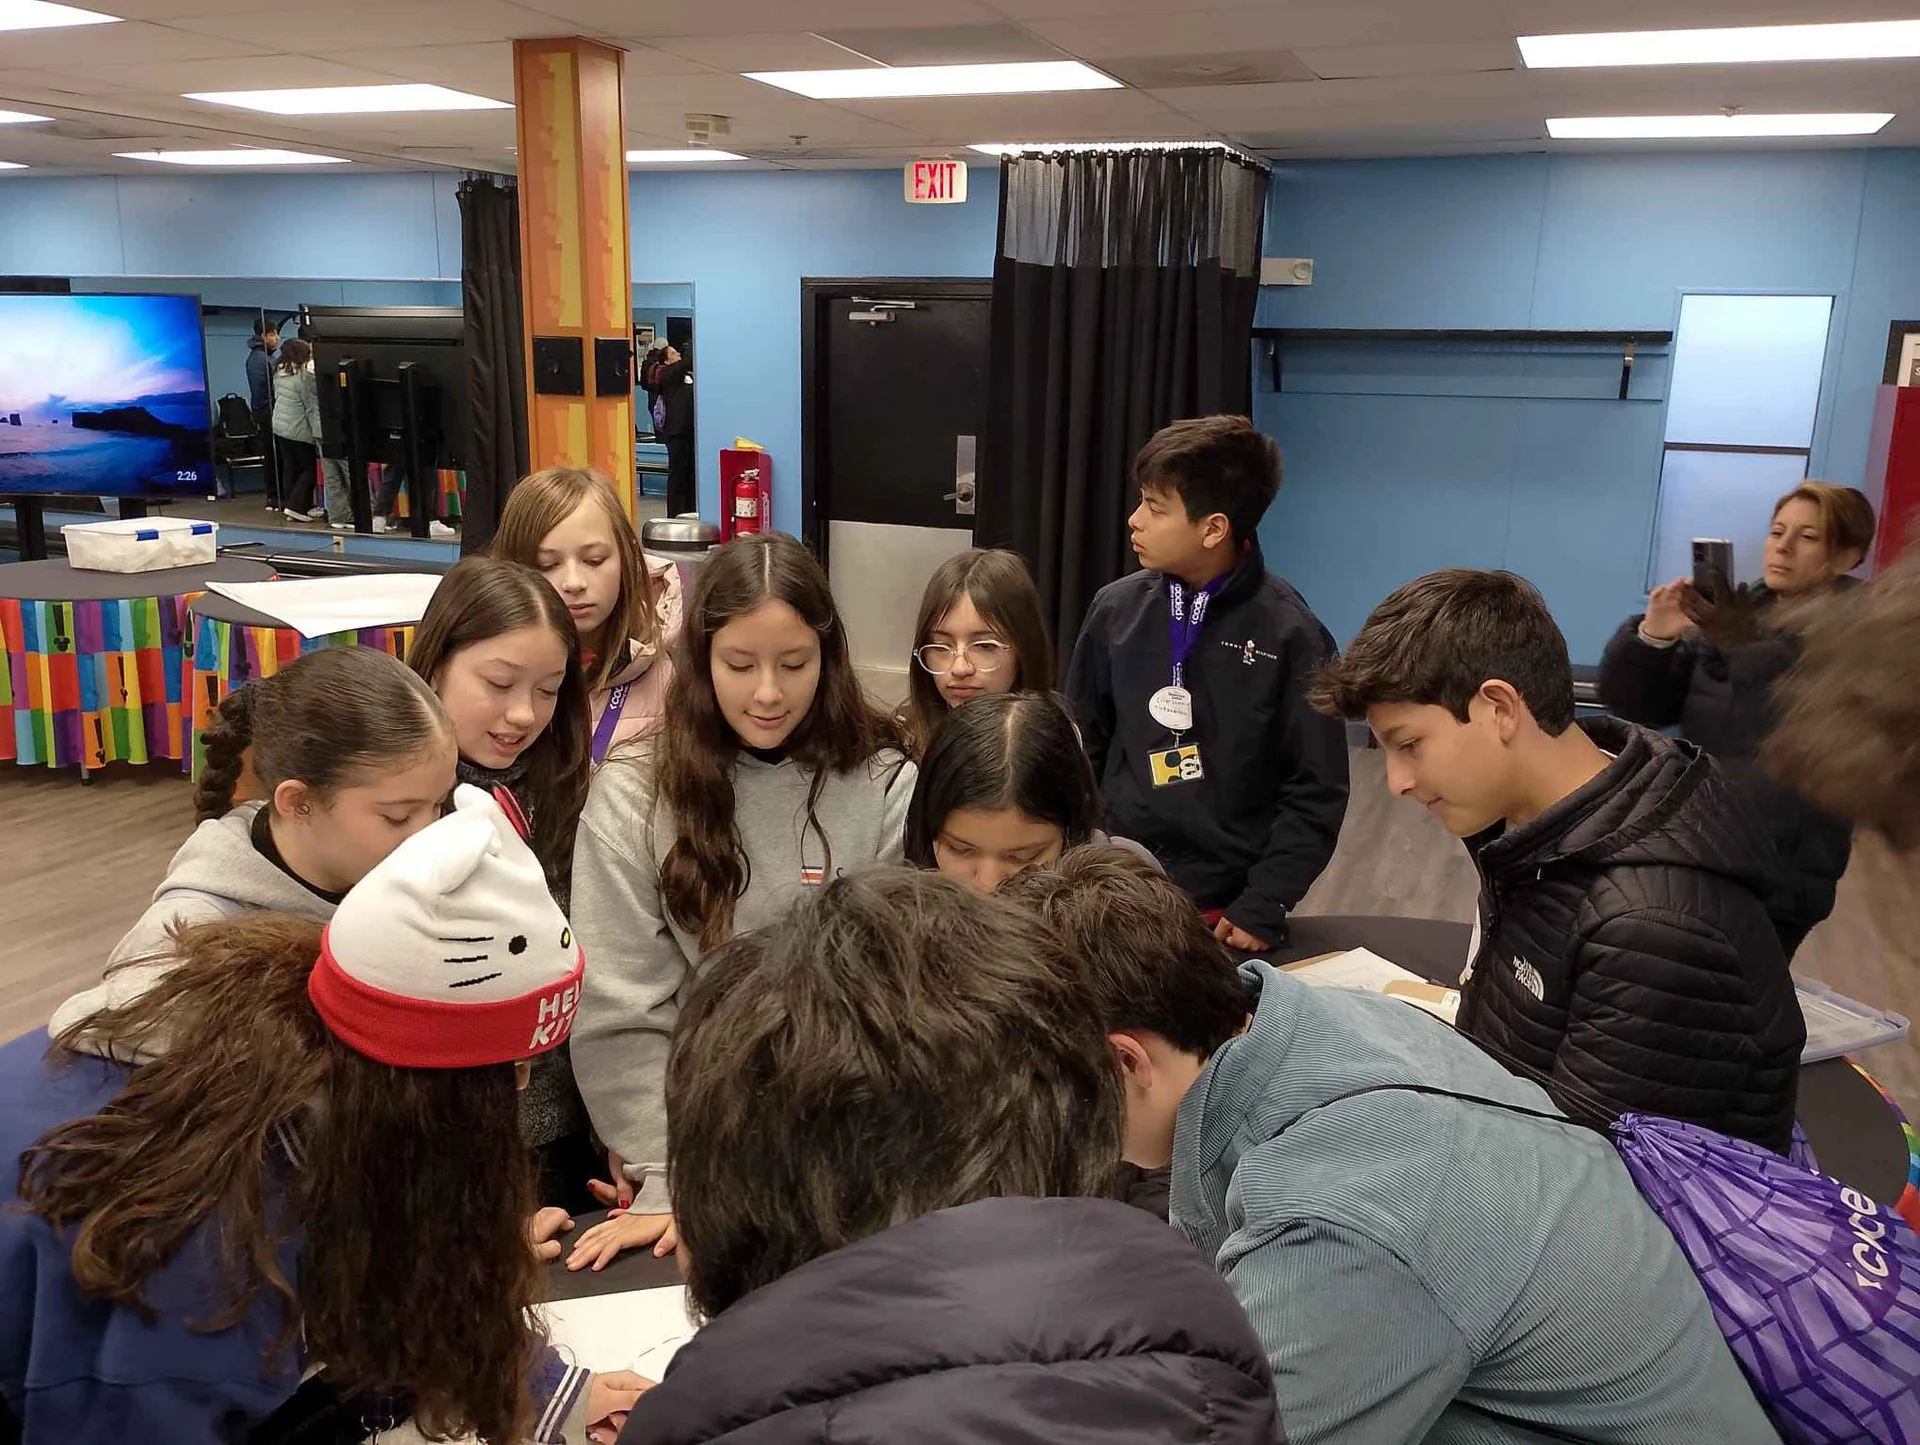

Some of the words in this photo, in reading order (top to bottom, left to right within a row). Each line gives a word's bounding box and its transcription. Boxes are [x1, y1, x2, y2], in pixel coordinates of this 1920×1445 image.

[914, 163, 957, 199] EXIT
[176, 470, 198, 481] 2:26
[538, 973, 585, 1024] HEL
